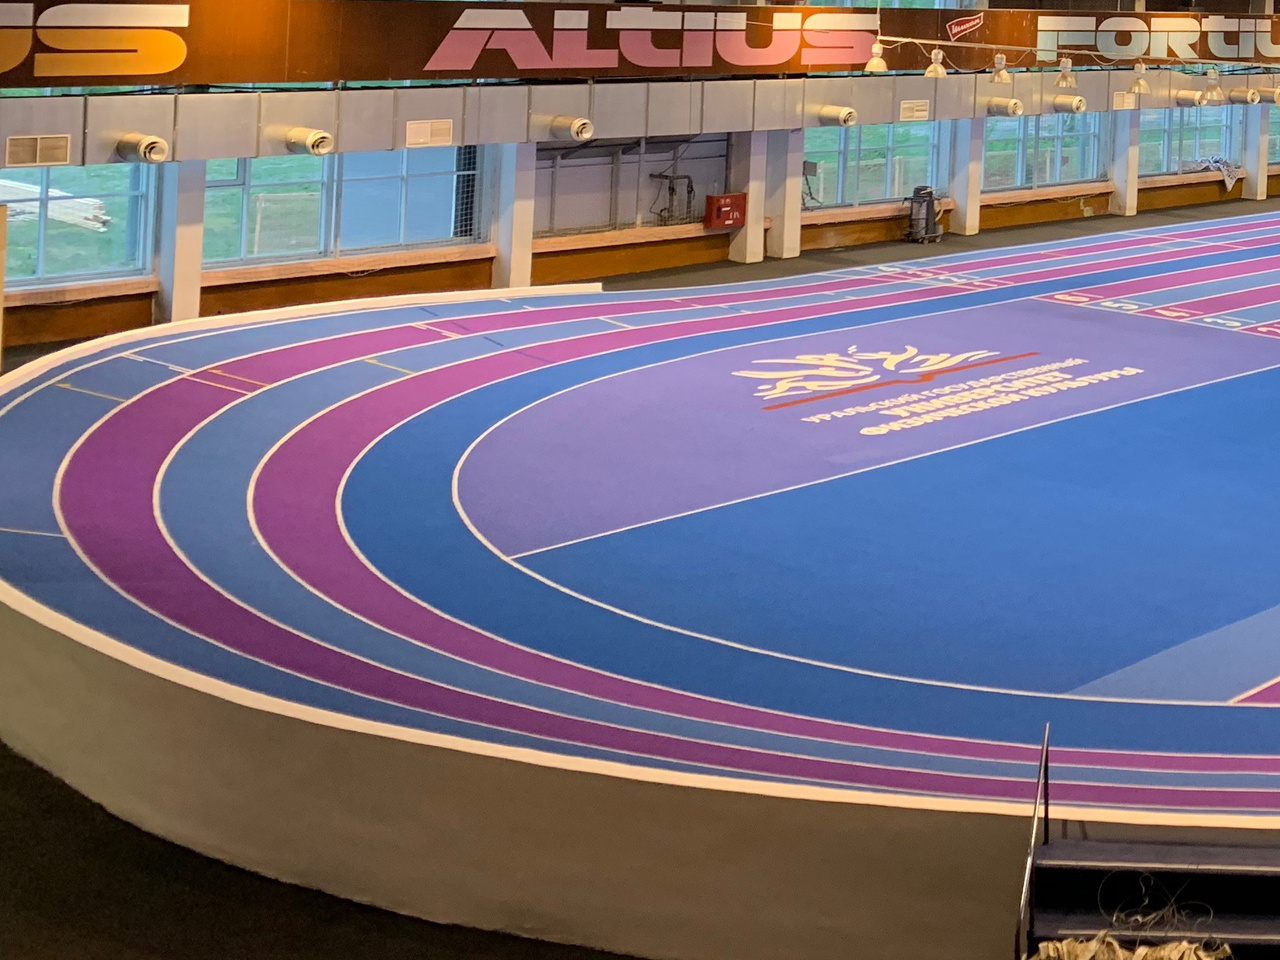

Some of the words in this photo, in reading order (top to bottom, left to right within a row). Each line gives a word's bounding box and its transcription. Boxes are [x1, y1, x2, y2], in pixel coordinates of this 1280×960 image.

[0, 3, 190, 77] S
[1053, 293, 1090, 302] 6
[1100, 301, 1139, 310] 5
[1154, 308, 1190, 317] 4
[1203, 317, 1242, 327] 3
[879, 371, 1074, 417] УНИВЕРСИТЕТ
[801, 393, 919, 423] УРАЛЬСКИЙ
